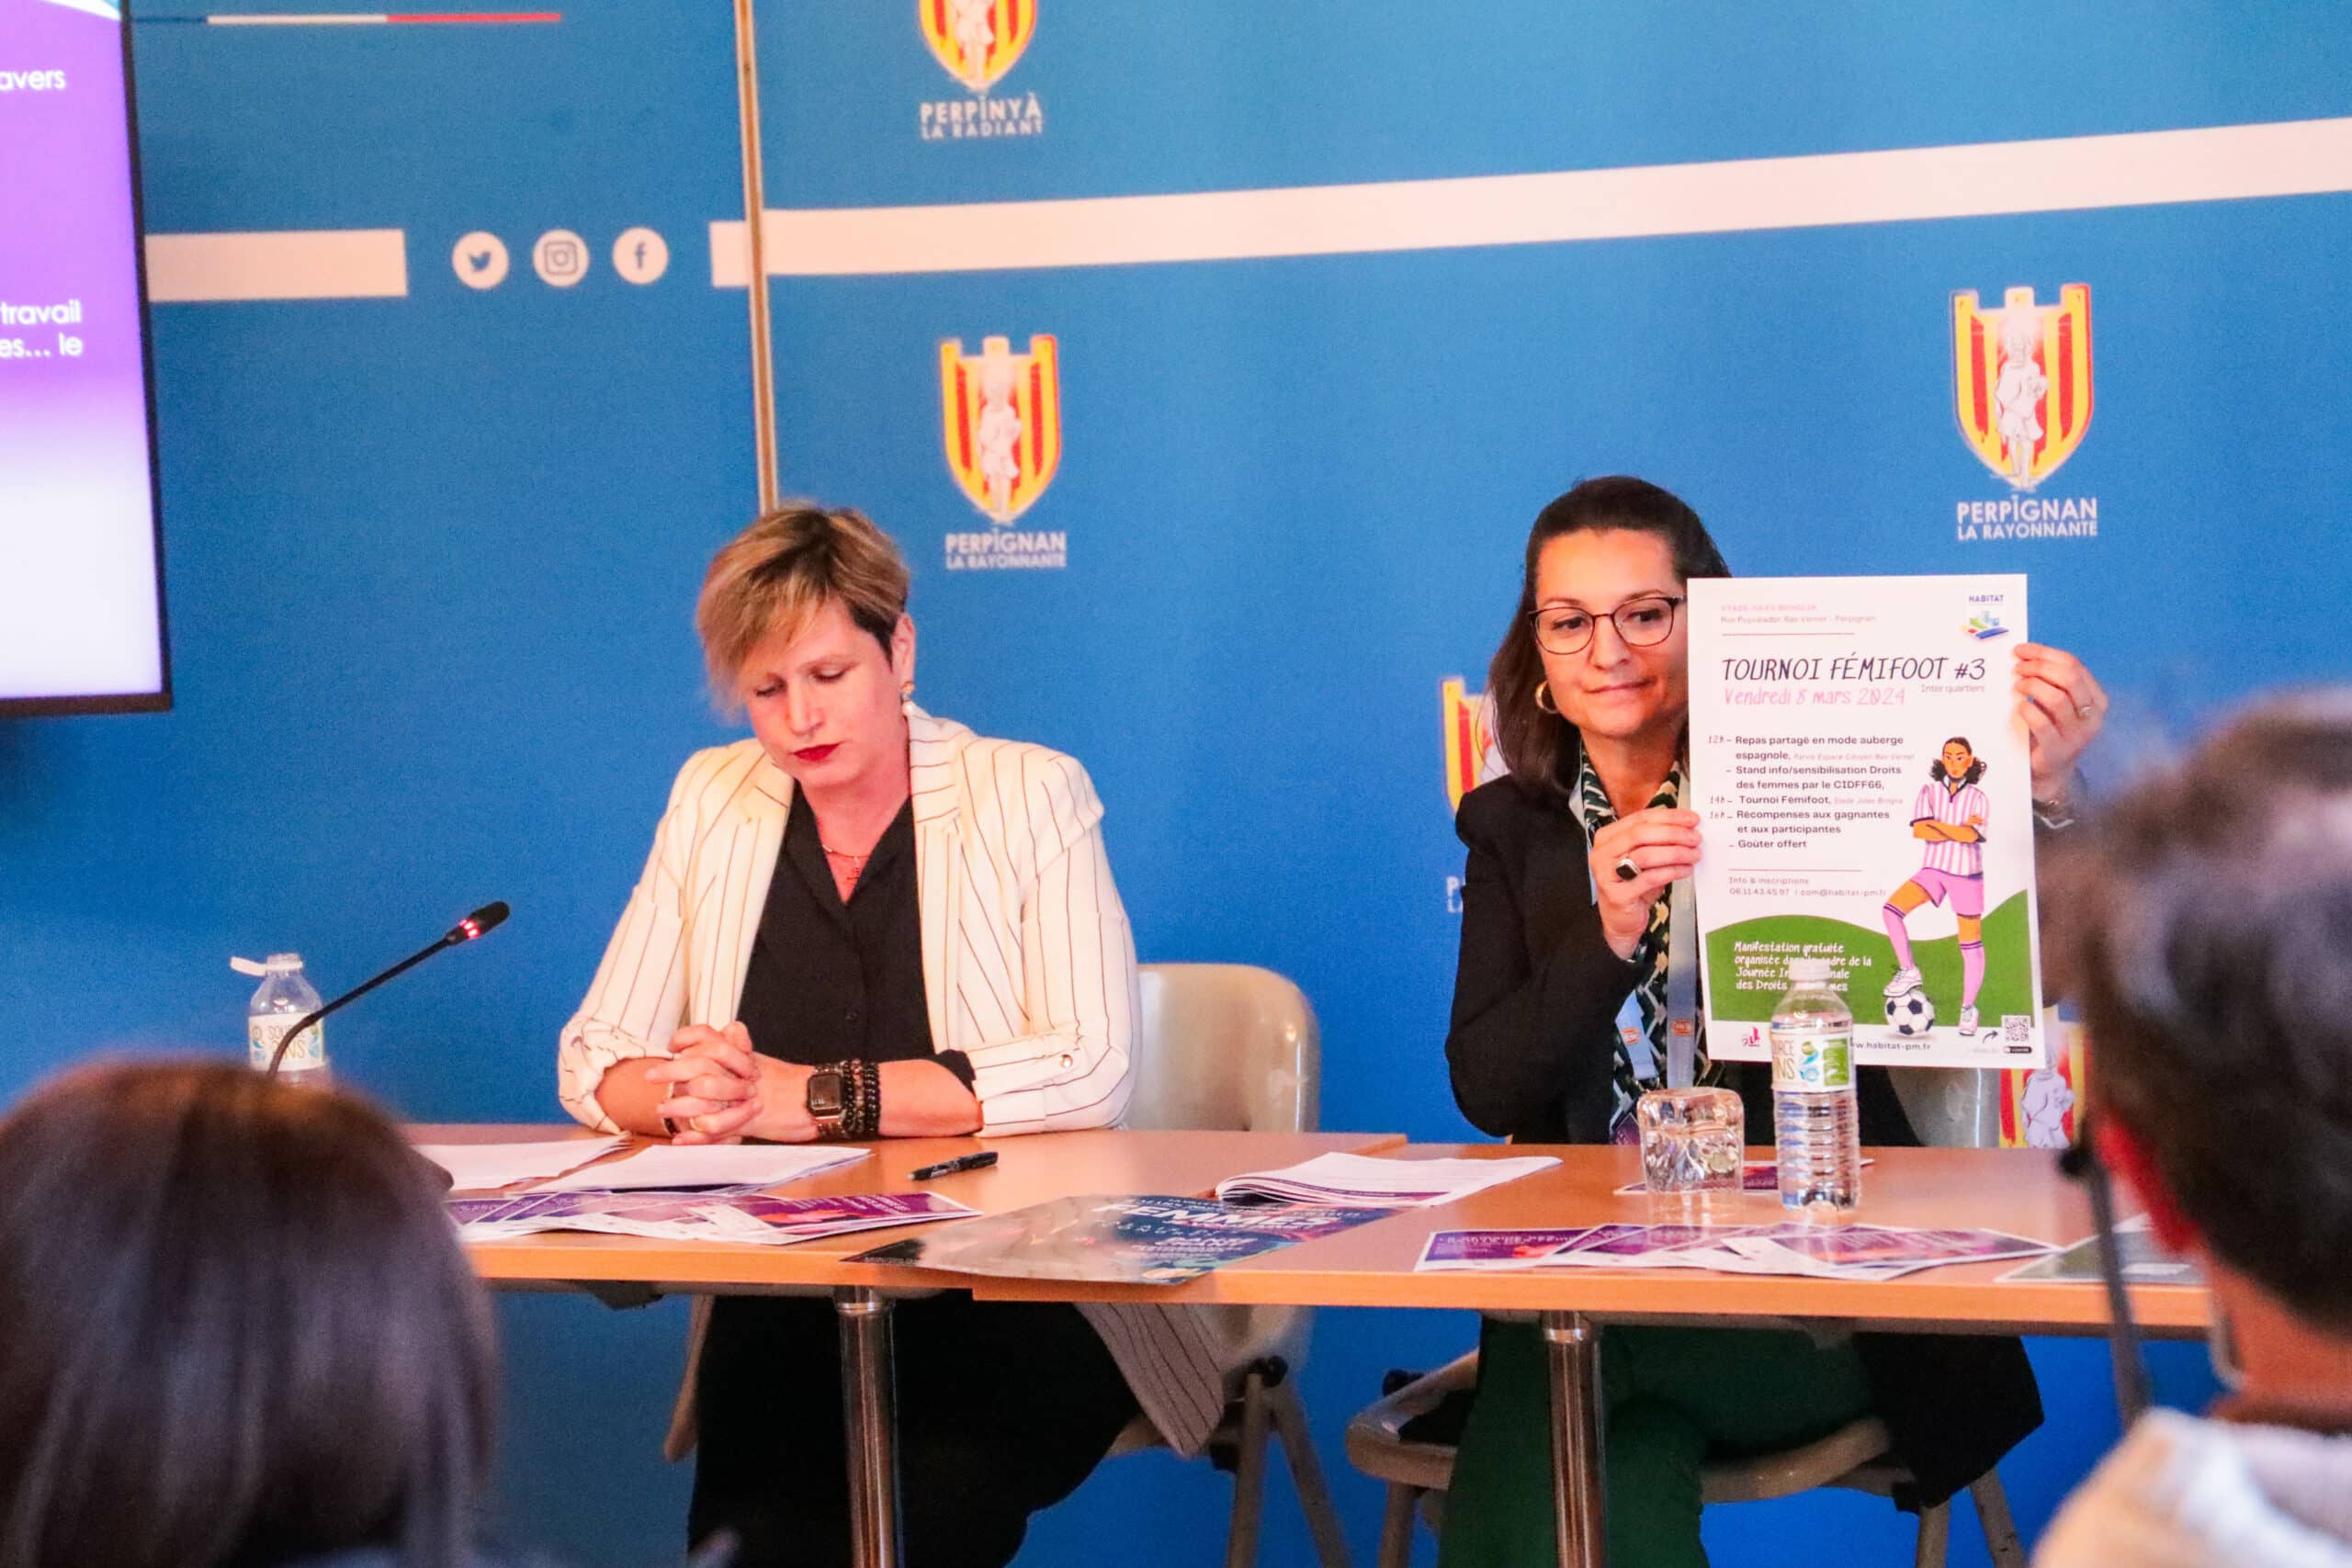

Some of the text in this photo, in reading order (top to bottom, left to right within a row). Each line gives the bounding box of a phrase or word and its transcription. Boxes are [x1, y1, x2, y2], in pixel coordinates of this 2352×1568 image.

[922, 118, 1044, 140] LA RADIANT
[0, 299, 82, 325] travail
[58, 332, 84, 356] le
[1957, 495, 2098, 524] PERPIGNAN
[1958, 520, 2098, 540] LA RAYONNANTE
[945, 527, 1068, 553] PERPIGNAN
[946, 551, 1068, 570] LA RAYONNANTE
[1968, 594, 2004, 603] HABITAT
[1722, 652, 1985, 682] TOURNOI FÉMIFOOT #3
[1724, 687, 1905, 705] Vendredi 8 mars 2024
[1736, 736, 1767, 746] Repas
[1769, 737, 1810, 746] partagé
[1827, 736, 1858, 744] mode
[1860, 736, 1904, 746] auberge
[1736, 766, 1766, 774] Stand
[1769, 766, 1867, 774] info/sensibilisation
[1736, 780, 1755, 788] des
[1802, 782, 1819, 790] par
[1740, 795, 1779, 805] Tournoi
[1834, 811, 1890, 820] gagnantes
[1736, 826, 1748, 834] et
[1771, 825, 1841, 835] participantes
[1777, 840, 1807, 848] offert
[1735, 941, 1845, 956] Manifestation gratuite
[1735, 954, 1781, 968] organisée
[1849, 956, 1861, 966] de
[1863, 955, 1872, 966] la
[1736, 967, 1776, 977] Journée
[1736, 979, 1753, 990] des
[1757, 979, 1788, 990] Droits
